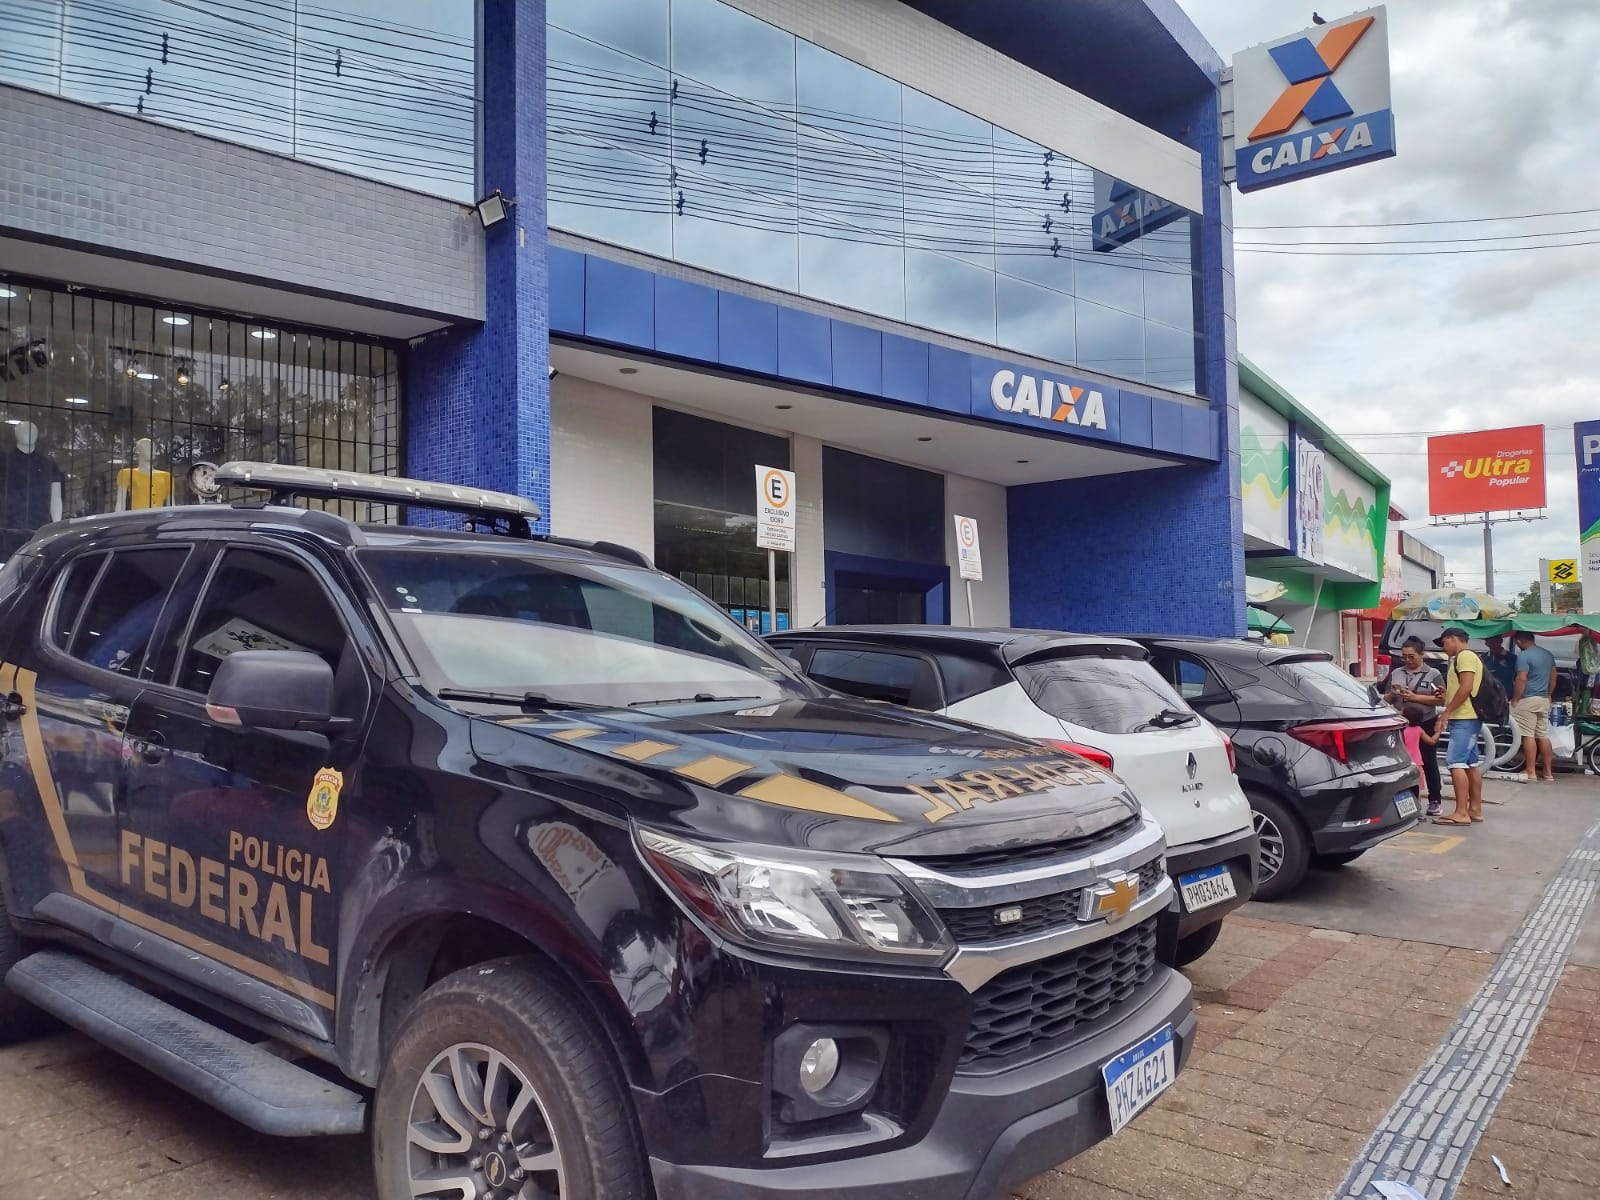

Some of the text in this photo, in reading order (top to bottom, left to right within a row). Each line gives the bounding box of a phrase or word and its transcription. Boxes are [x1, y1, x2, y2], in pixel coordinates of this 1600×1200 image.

[1251, 122, 1373, 175] CAIXA
[991, 369, 1106, 431] CAIXA
[771, 478, 782, 499] E
[1463, 457, 1531, 479] Ultra
[1489, 475, 1531, 487] Popular
[121, 829, 330, 966] FEDERAL
[1115, 1049, 1168, 1123] PHZ4G21
